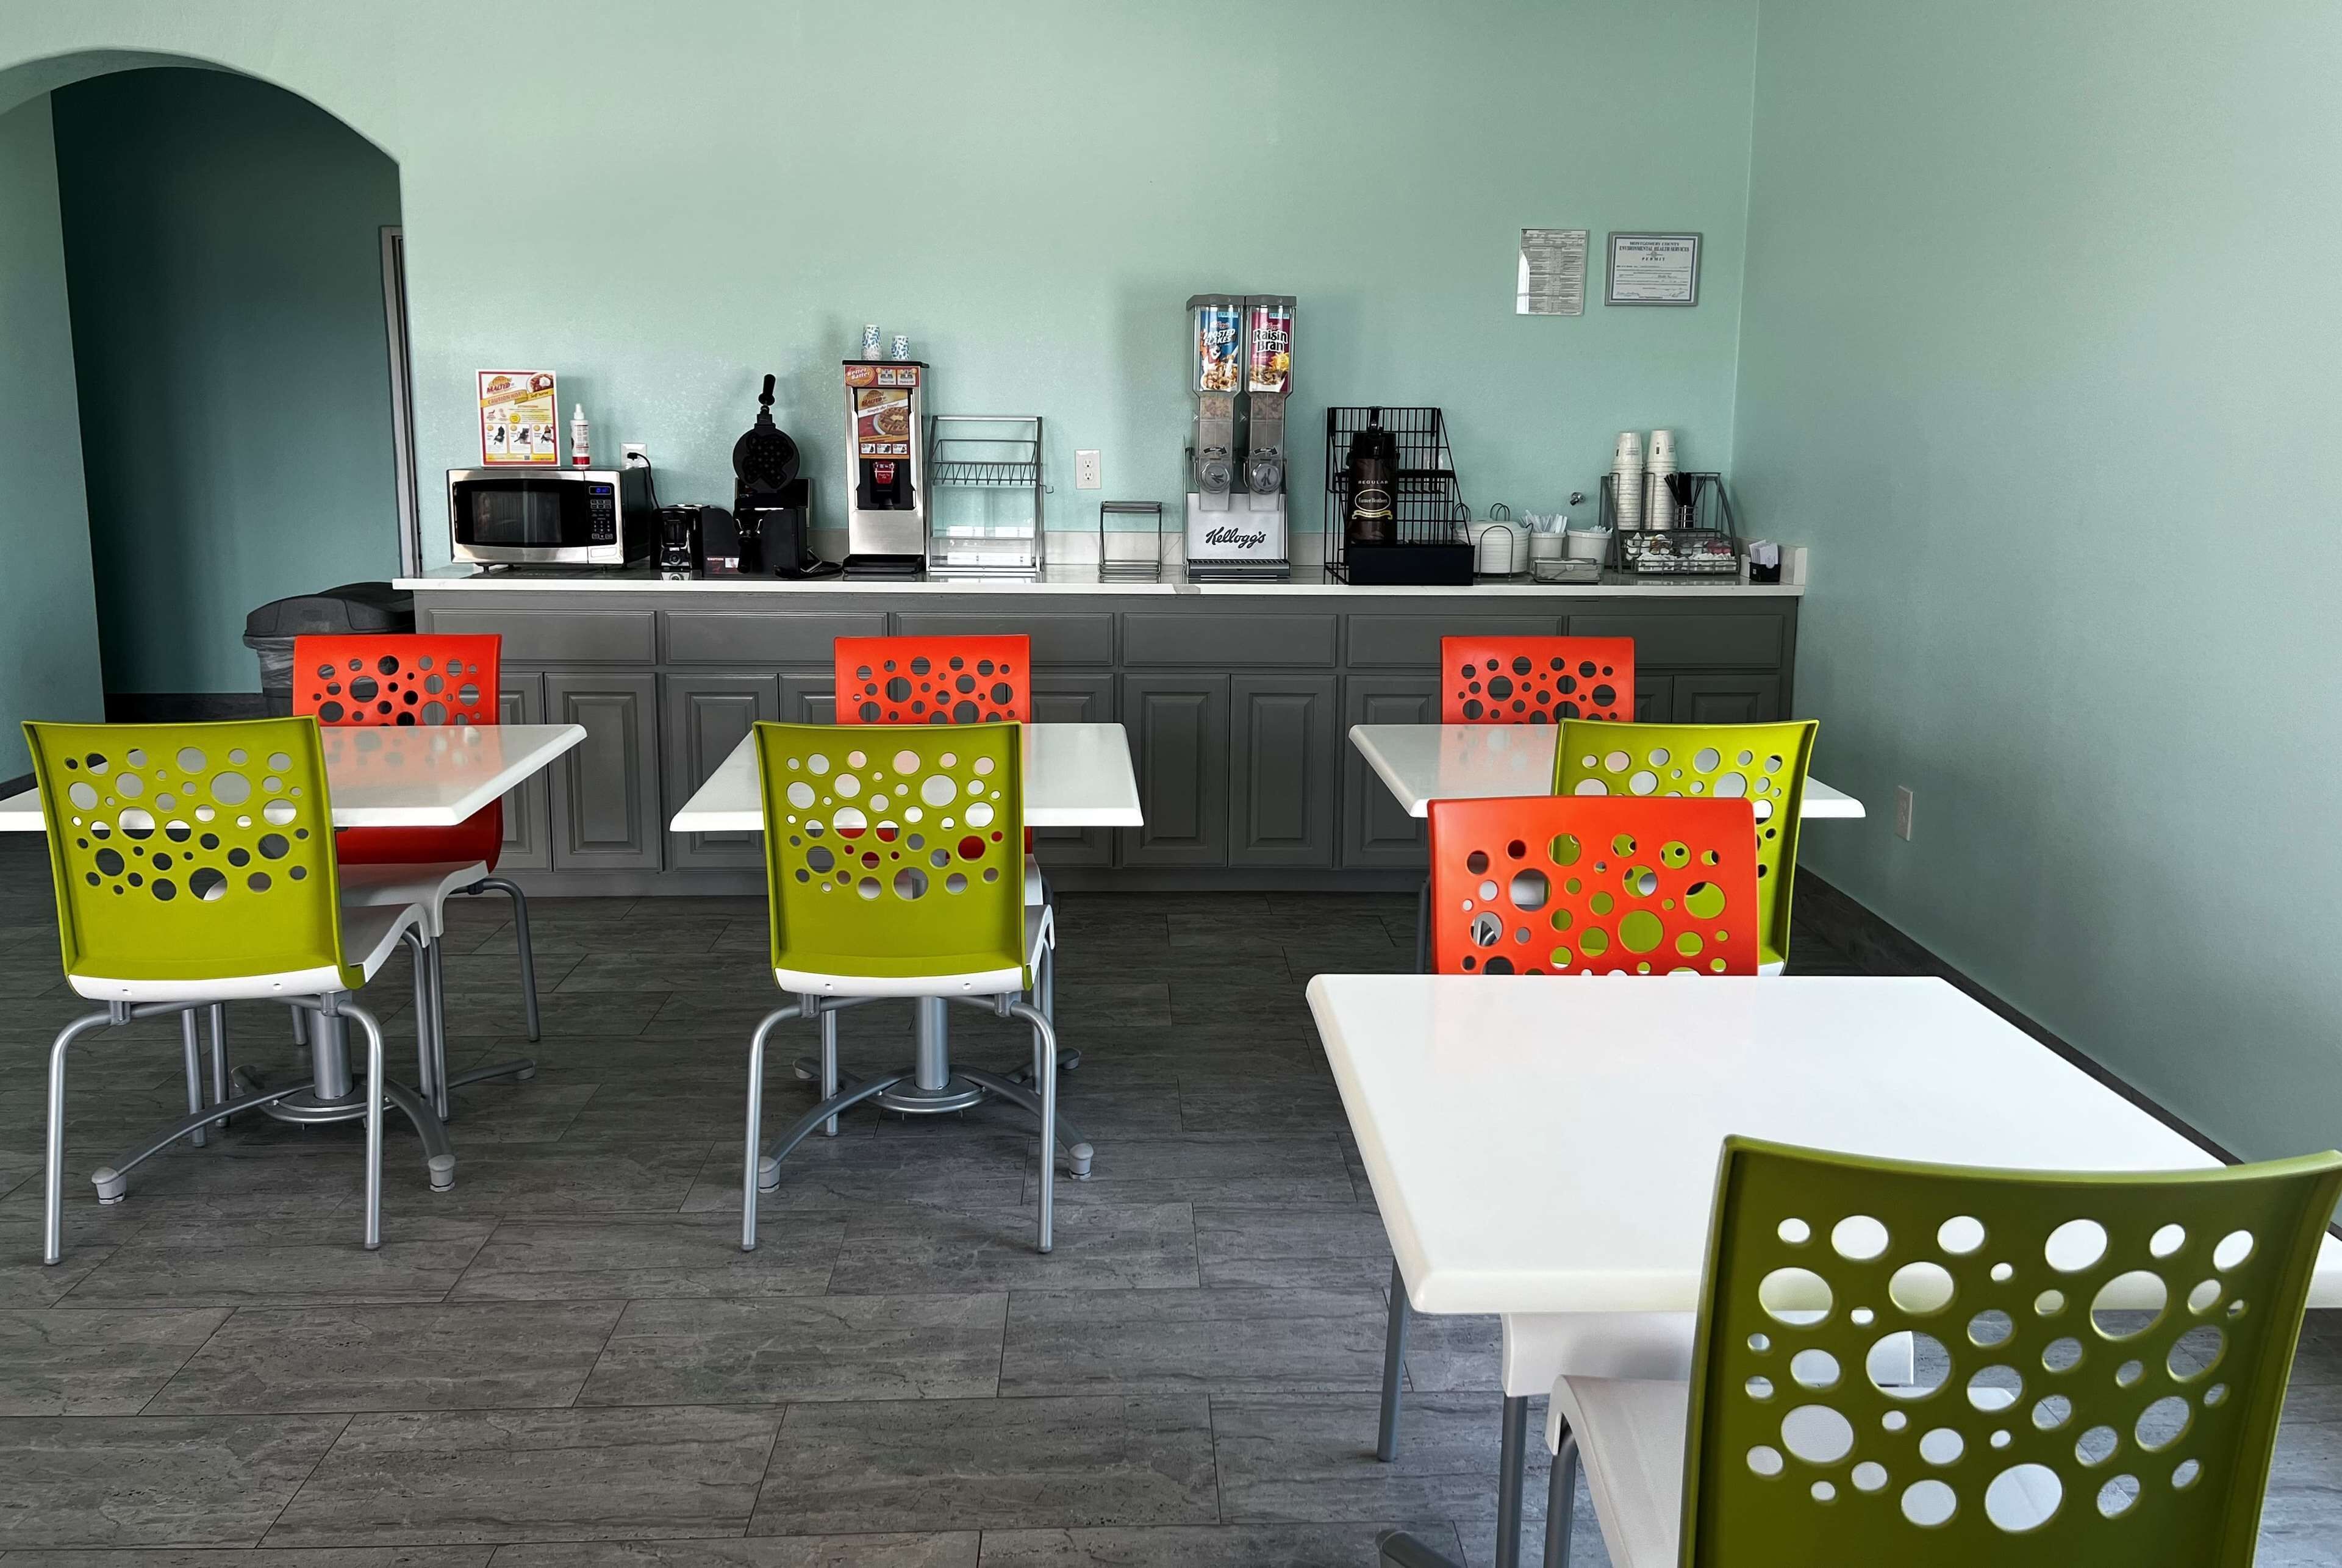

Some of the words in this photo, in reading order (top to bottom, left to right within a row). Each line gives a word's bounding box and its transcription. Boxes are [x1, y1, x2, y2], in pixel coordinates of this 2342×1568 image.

[1203, 329, 1236, 340] FROSTED
[1254, 330, 1287, 343] Raisin
[1203, 336, 1232, 346] FLAKES
[1257, 341, 1284, 352] Bran
[1206, 526, 1266, 549] Kellogg's
